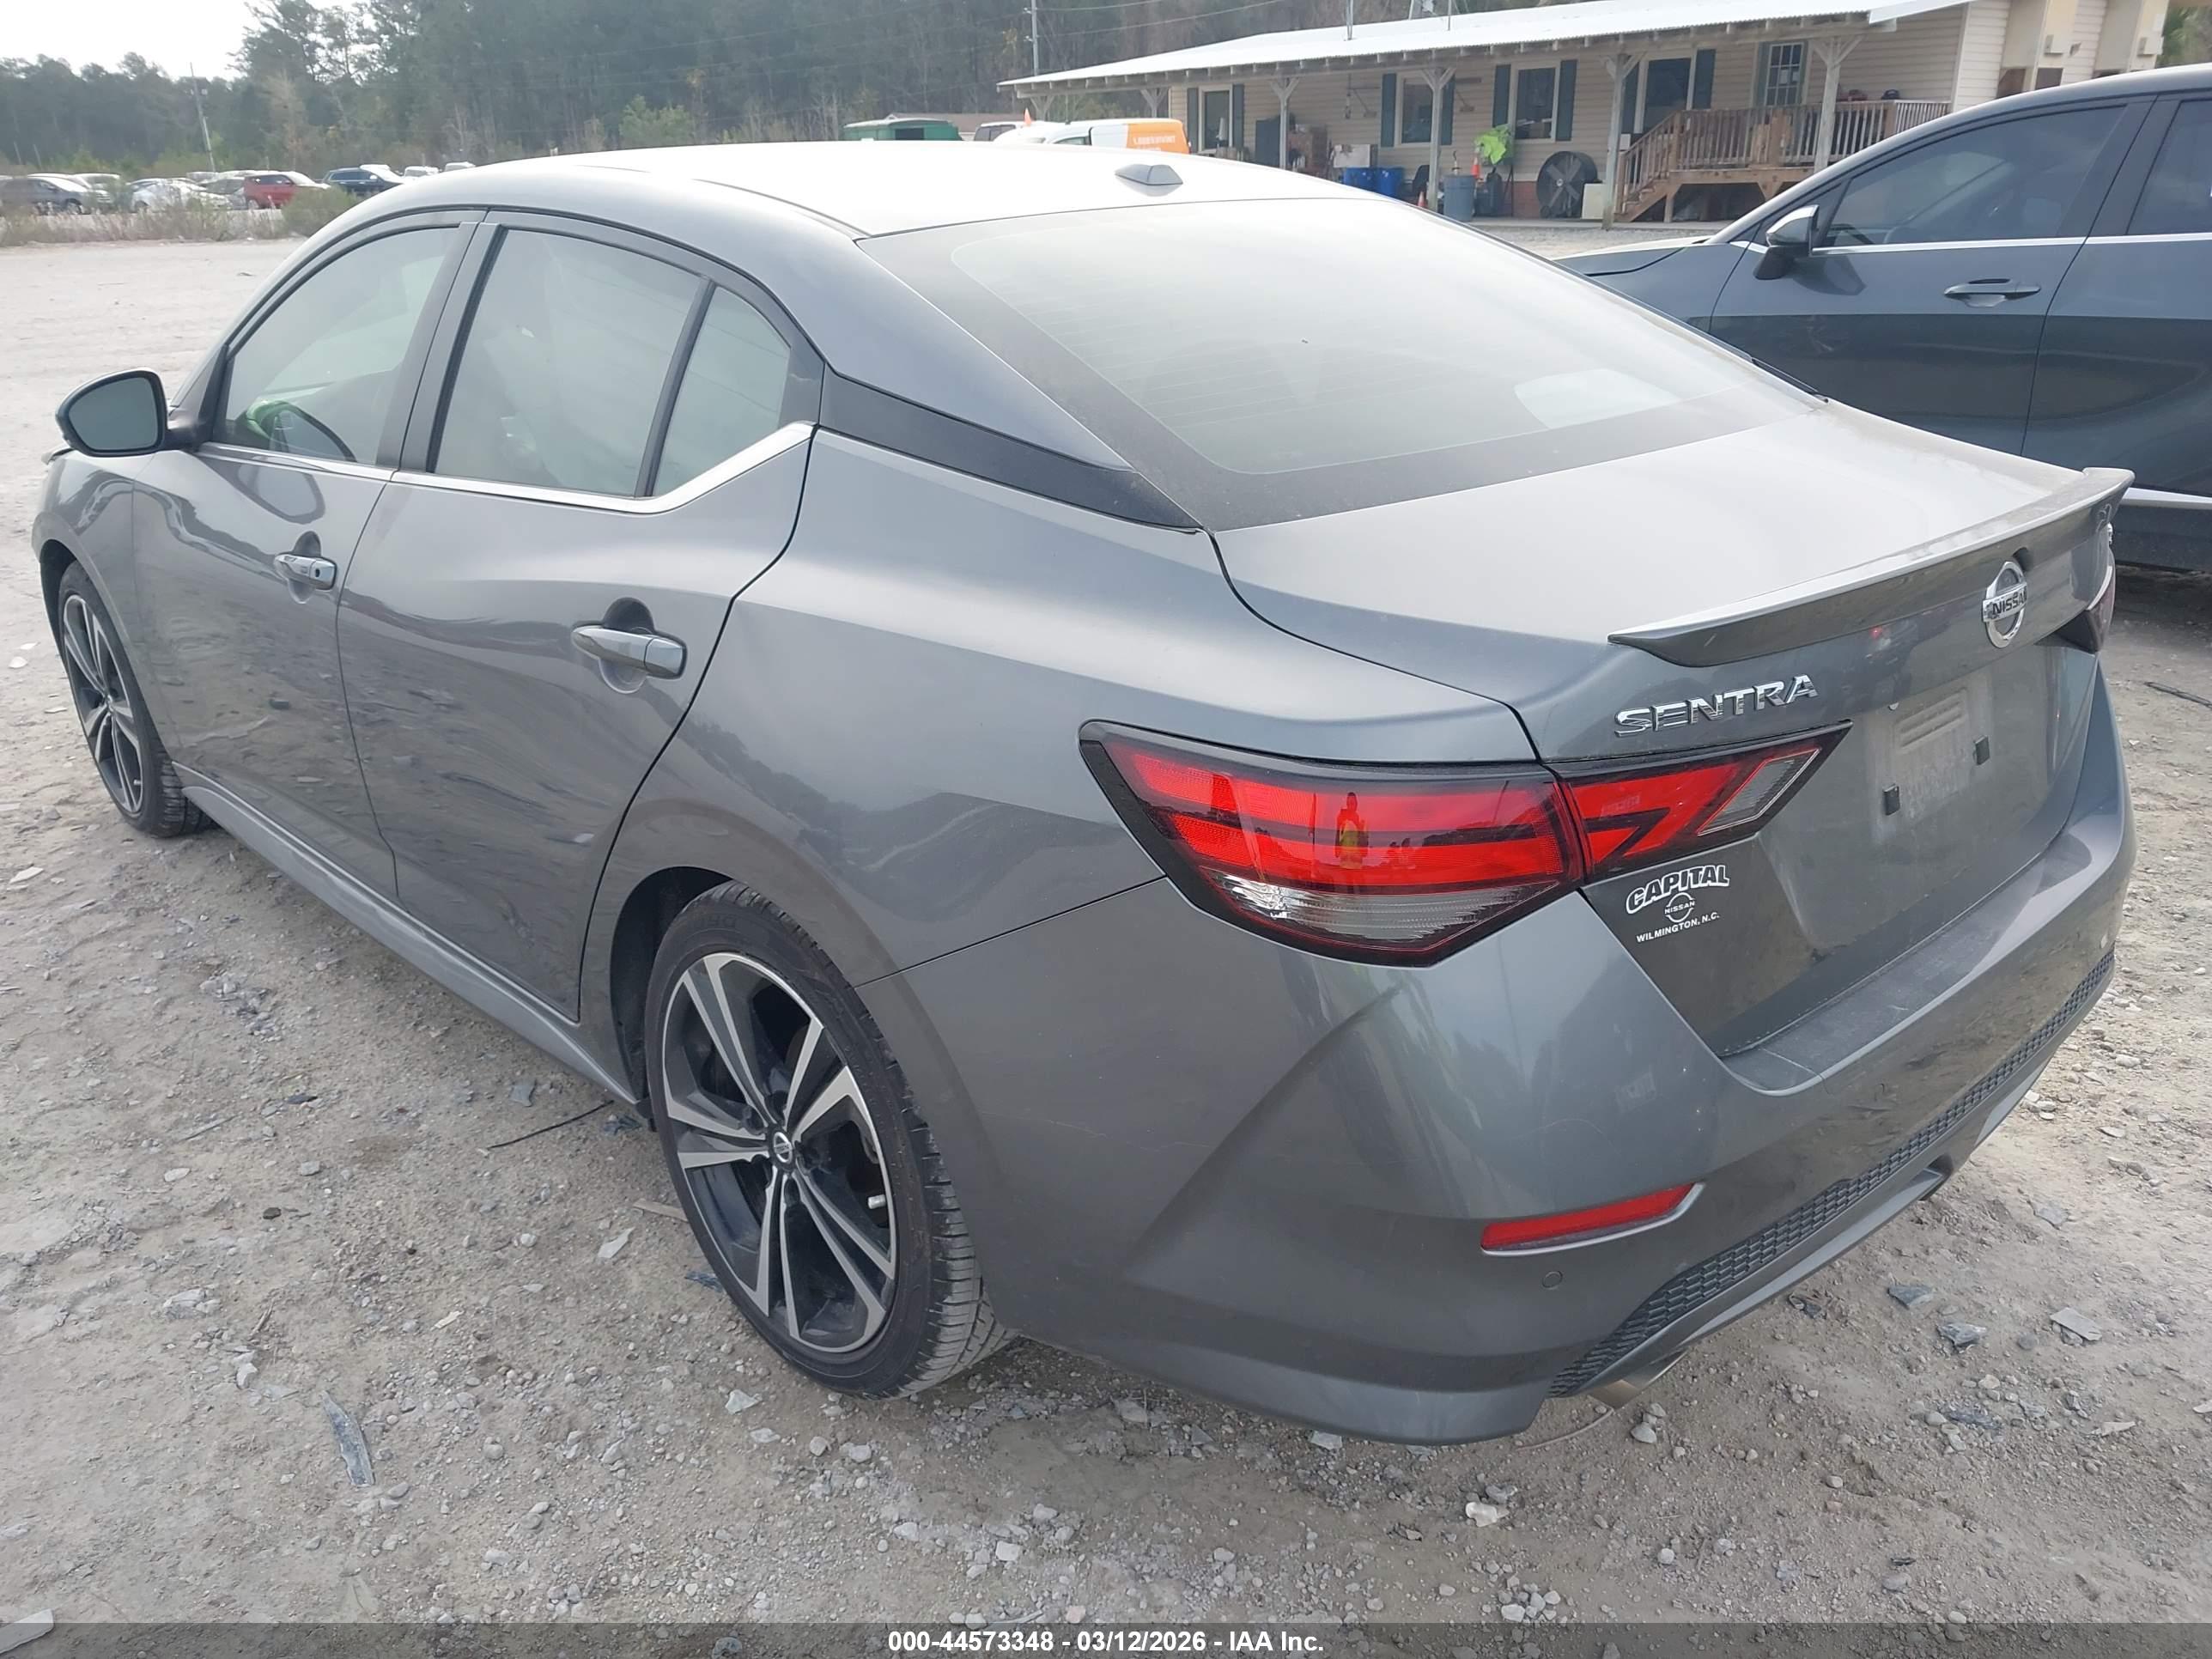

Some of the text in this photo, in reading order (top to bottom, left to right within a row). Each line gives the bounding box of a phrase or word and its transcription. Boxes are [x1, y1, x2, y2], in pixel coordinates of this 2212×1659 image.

[1614, 673, 1819, 738] SENTRA
[1626, 865, 1730, 915] CAPITAL
[1664, 901, 1696, 915] NISSAN
[1636, 912, 1720, 943] WILMINGTON, N.C.
